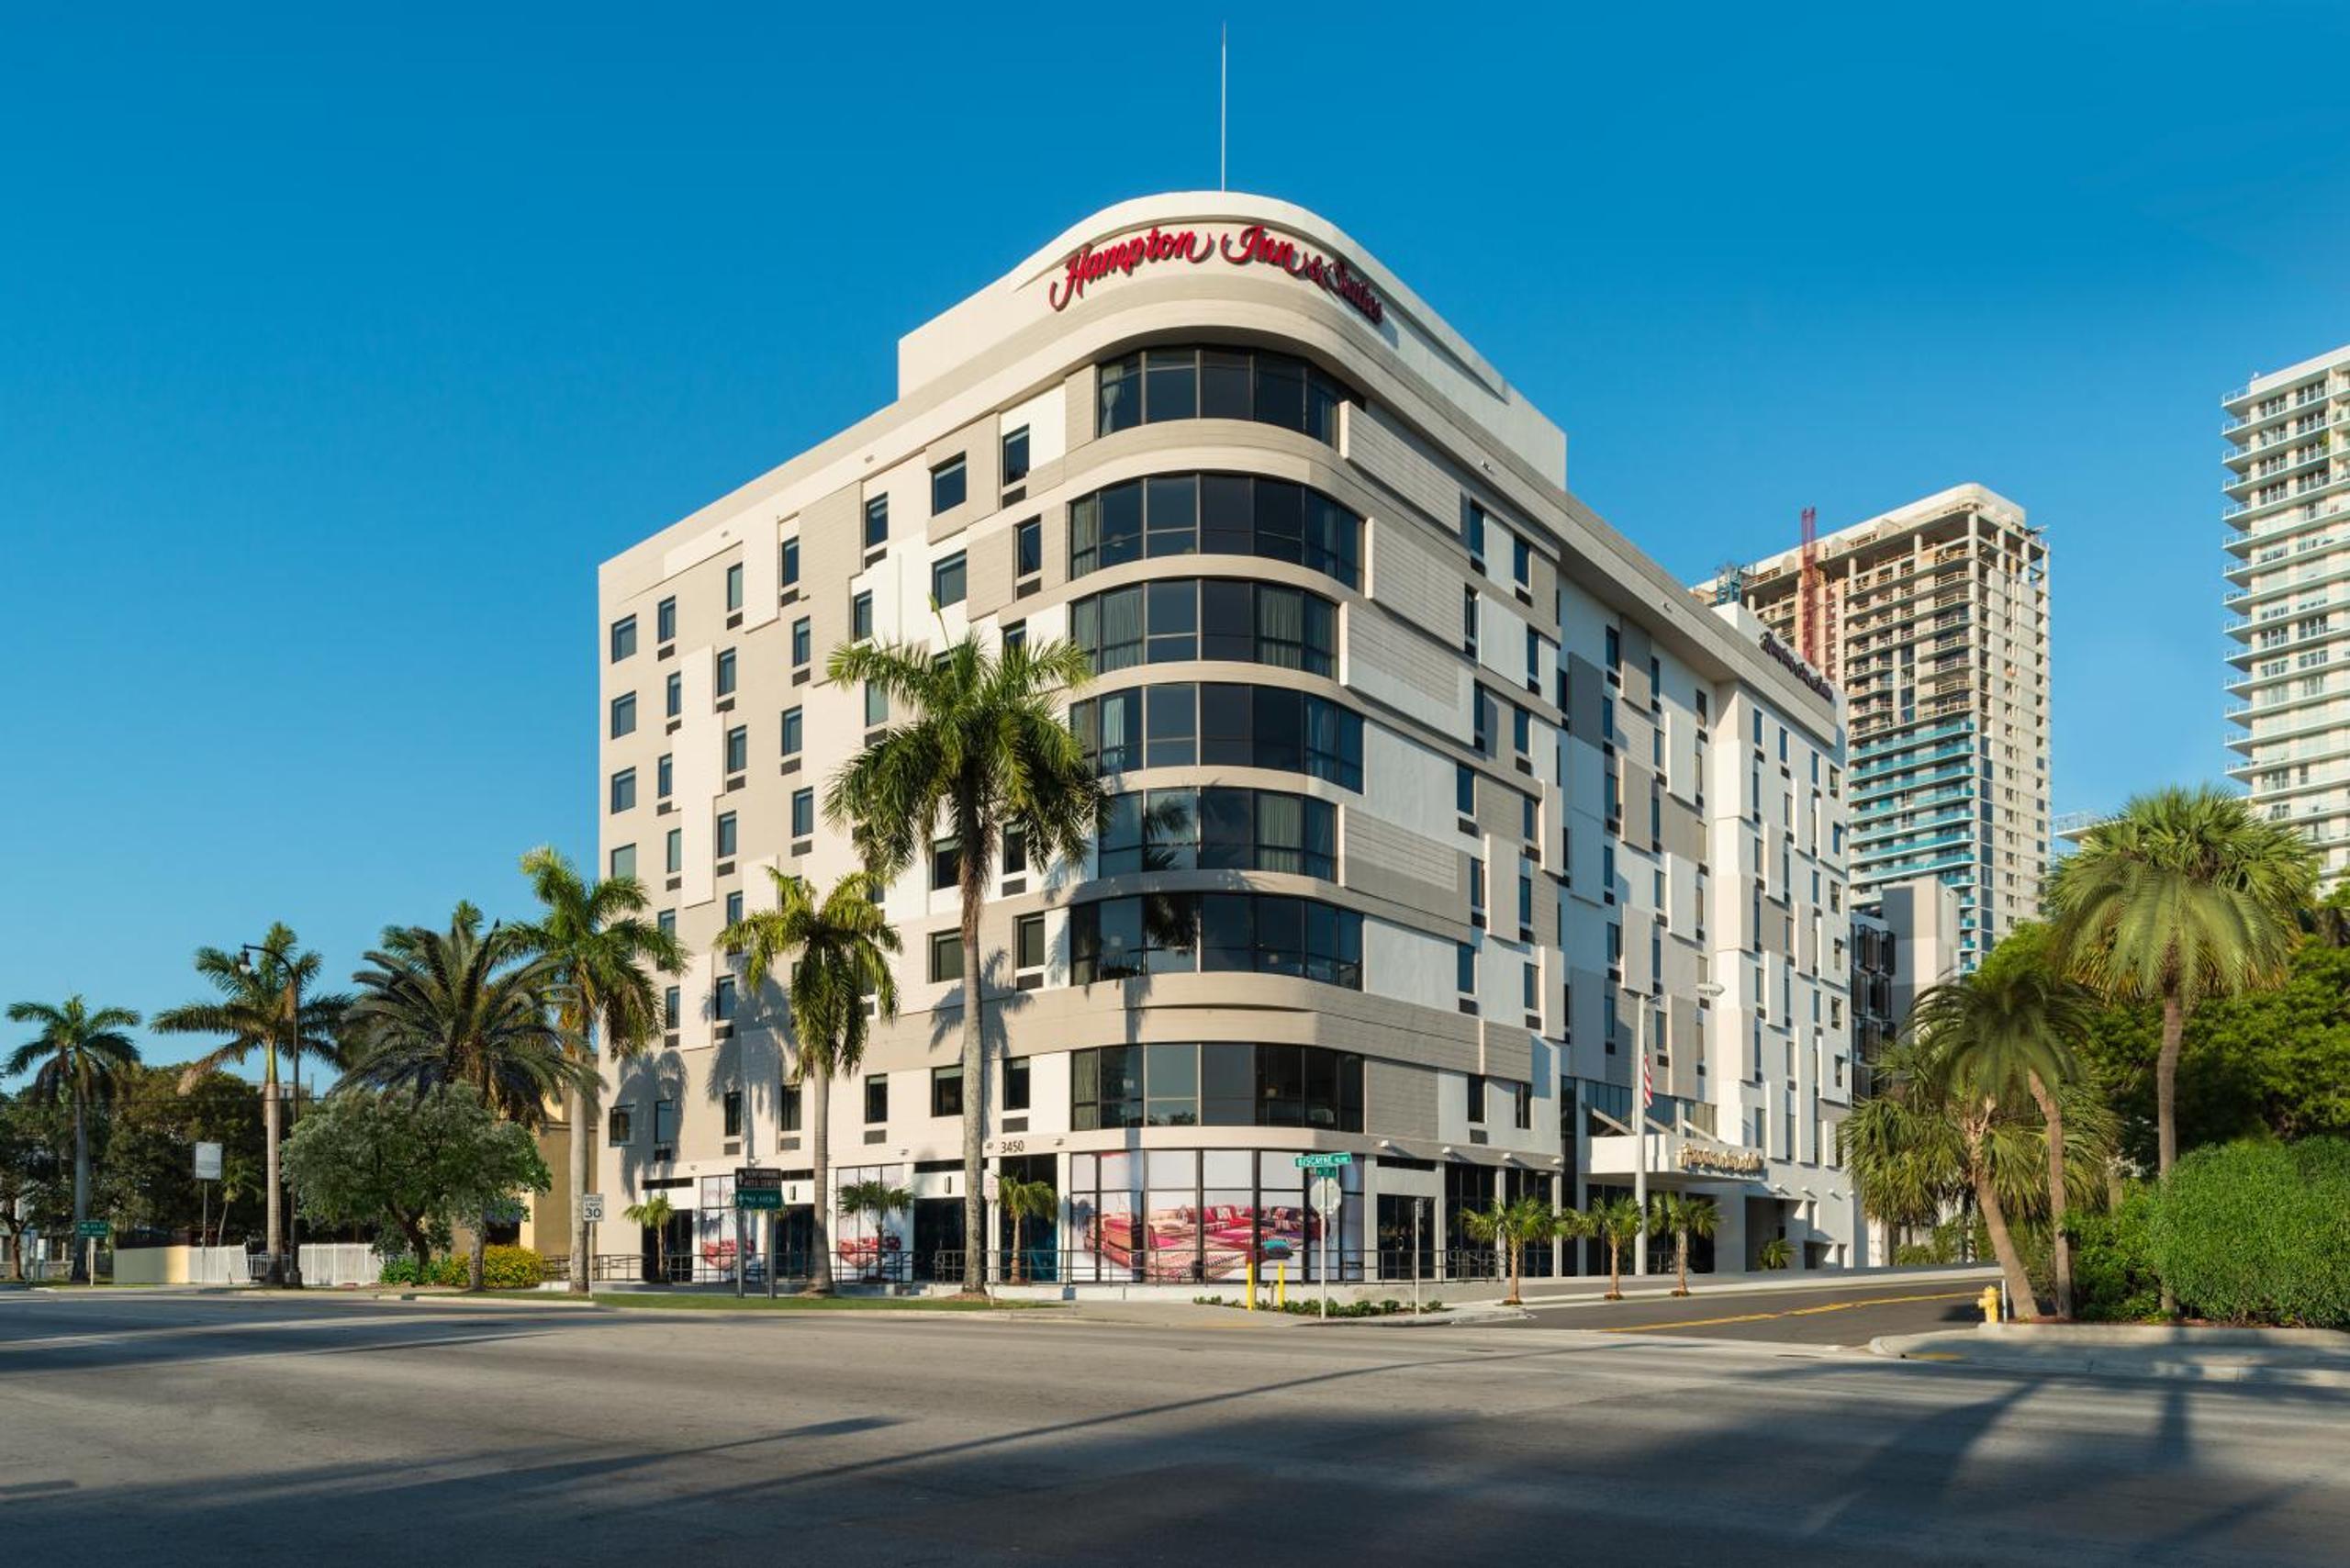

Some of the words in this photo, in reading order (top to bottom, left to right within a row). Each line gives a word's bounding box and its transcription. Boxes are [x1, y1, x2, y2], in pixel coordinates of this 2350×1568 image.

[1049, 225, 1213, 311] Hampton
[1221, 225, 1307, 274] Inn
[1001, 1139, 1024, 1154] 3450
[585, 1207, 602, 1218] 30
